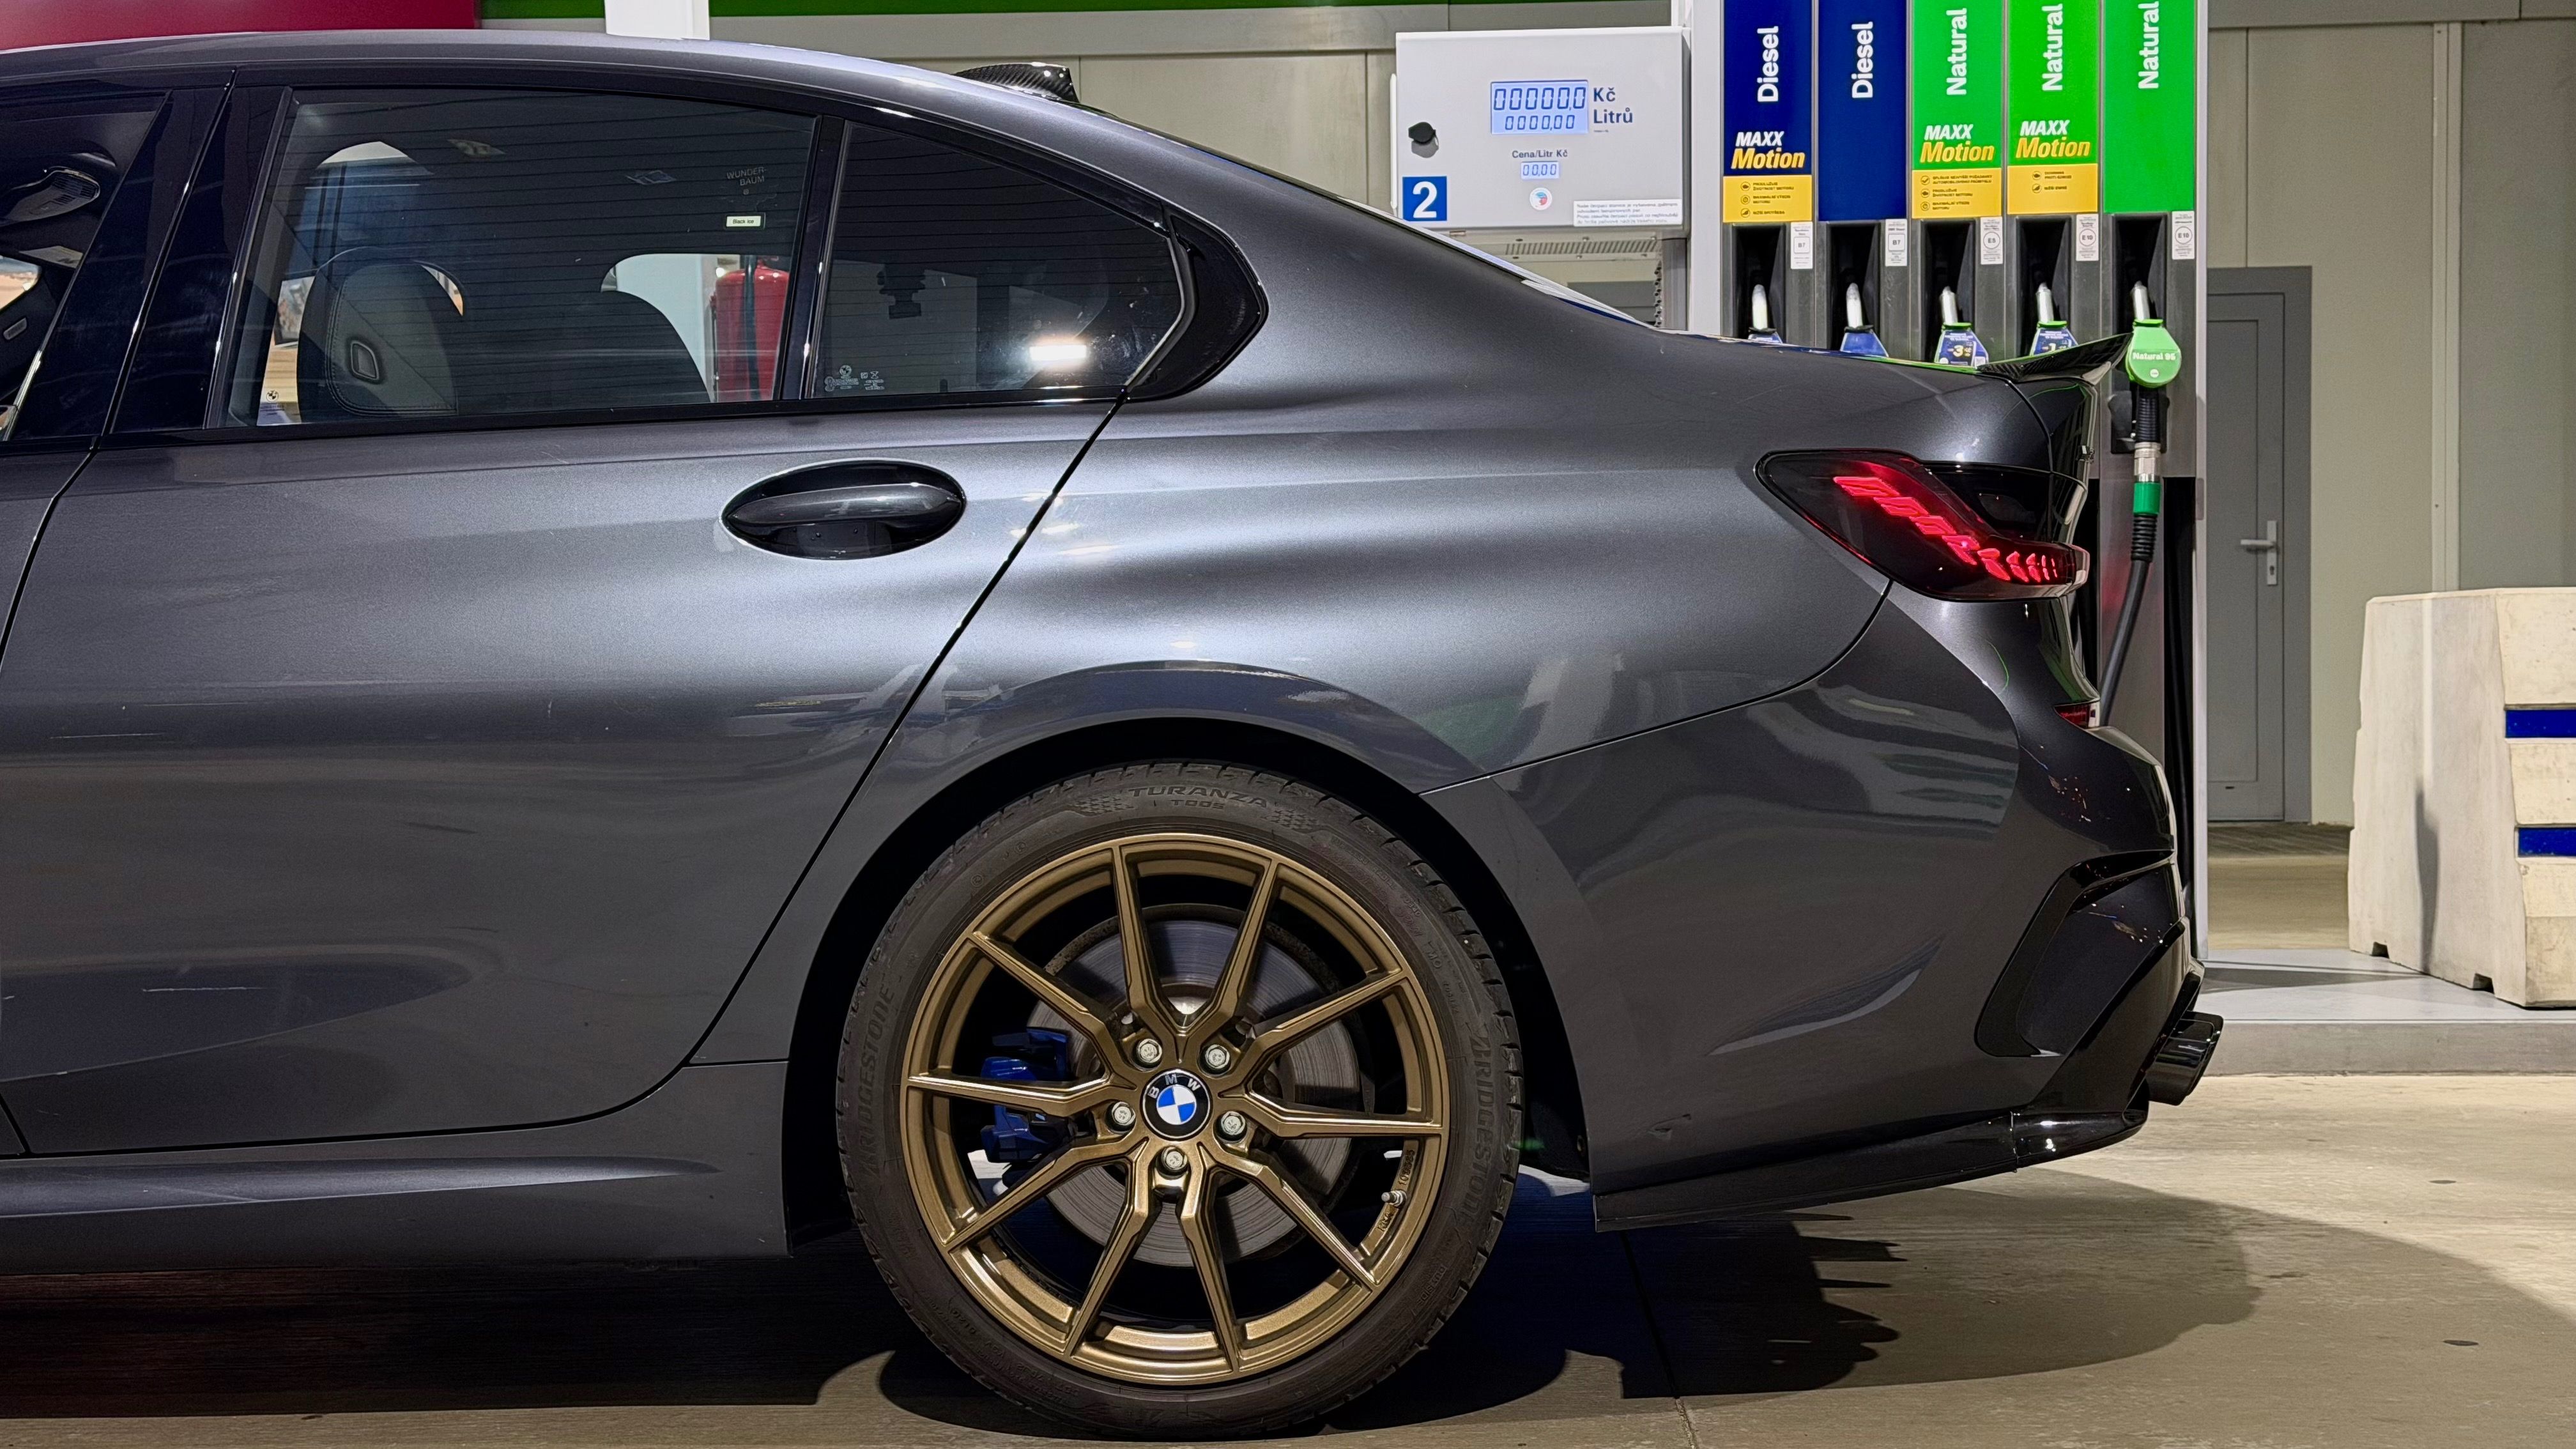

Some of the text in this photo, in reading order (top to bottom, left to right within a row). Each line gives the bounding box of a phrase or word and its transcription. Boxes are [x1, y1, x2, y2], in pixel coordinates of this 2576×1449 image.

[1946, 8, 1967, 95] Natural
[2042, 3, 2063, 91] Natural
[2138, 1, 2159, 89] Natural
[1757, 26, 1779, 102] Diesel
[1851, 21, 1873, 98] Diesel
[1593, 87, 1616, 102] Kč
[1593, 107, 1633, 124] Litrů
[1924, 124, 1974, 141] MAXX
[2020, 119, 2070, 136] MAXX
[1735, 131, 1784, 147] MAXX
[2015, 136, 2090, 158] Motion
[1512, 150, 1553, 158] Cena/Litr
[1730, 148, 1805, 169] Motion
[1919, 141, 1995, 164] Motion
[726, 167, 767, 180] WUNDER-
[740, 175, 765, 186] BAUM
[1413, 181, 1438, 219] 2
[1128, 785, 1268, 808] TURANZA
[1170, 799, 1225, 809] T005
[857, 984, 894, 1181] BRIDGESTONE
[1148, 1073, 1201, 1099] BMW
